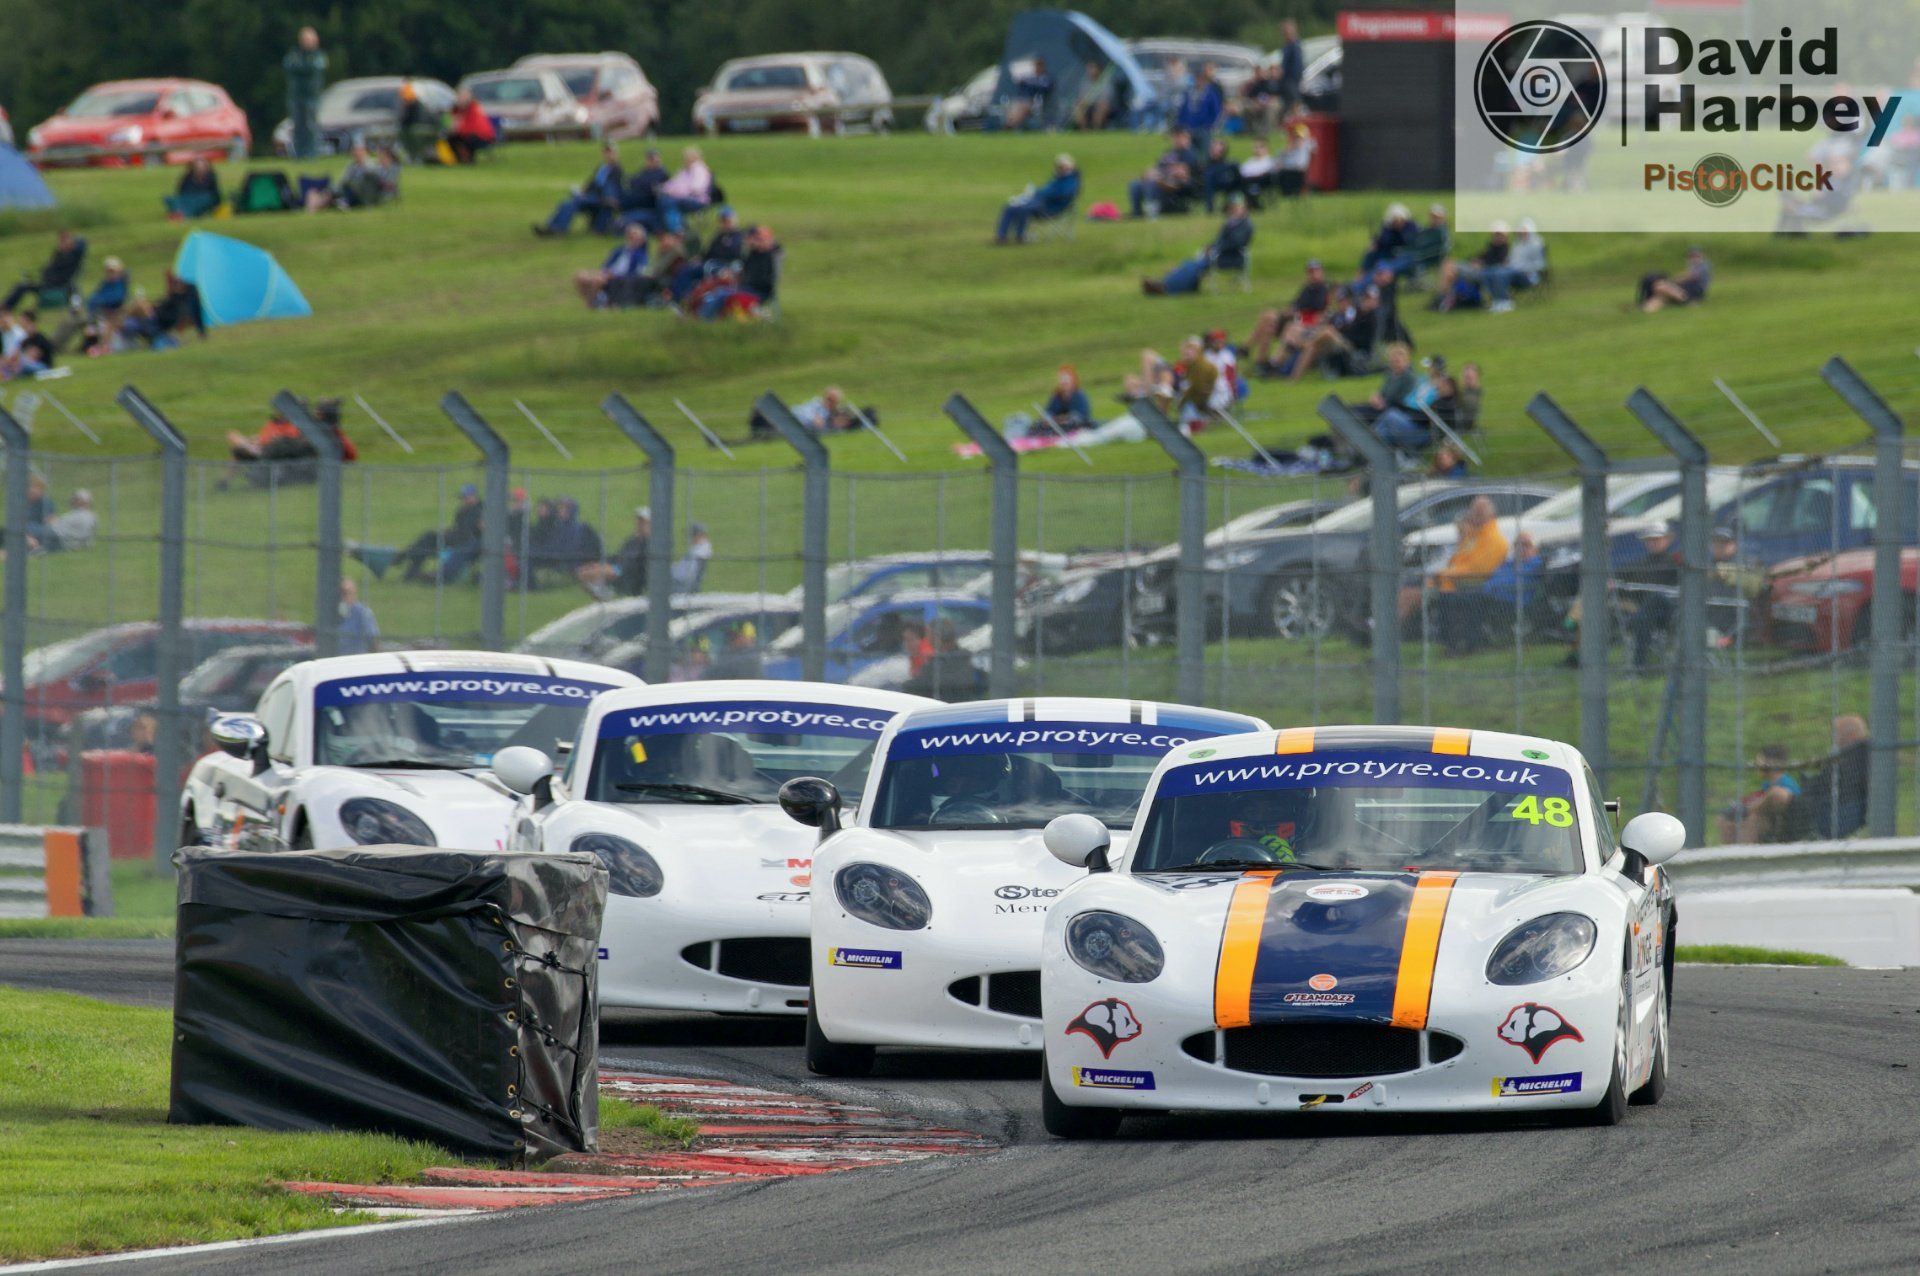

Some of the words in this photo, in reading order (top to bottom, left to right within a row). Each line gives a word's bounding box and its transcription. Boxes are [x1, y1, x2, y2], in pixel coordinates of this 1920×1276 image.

[1194, 759, 1540, 786] www.protyre.co.uk
[1511, 795, 1574, 828] 48
[847, 954, 893, 964] MICHELIN
[1094, 1075, 1145, 1084] MICHELIN
[1518, 1079, 1573, 1091] MICHELIN
